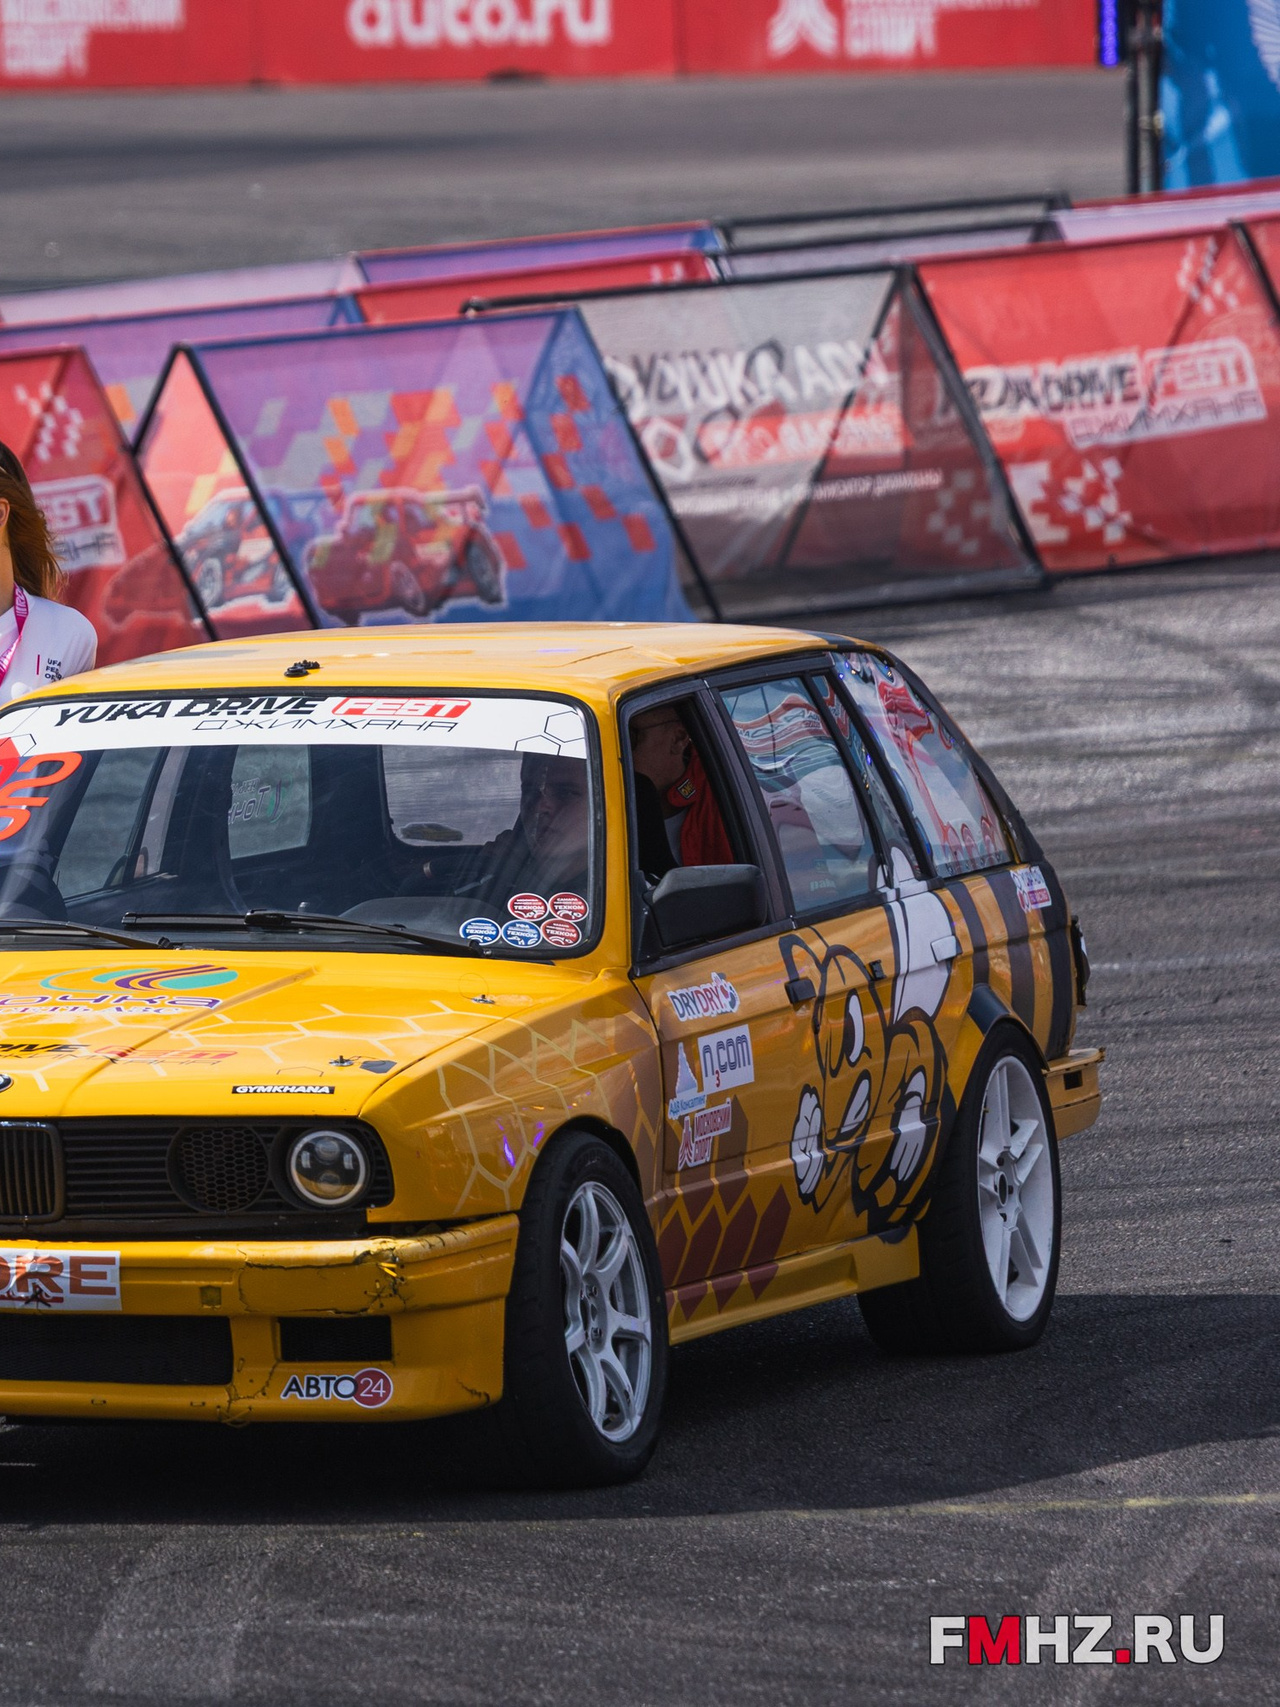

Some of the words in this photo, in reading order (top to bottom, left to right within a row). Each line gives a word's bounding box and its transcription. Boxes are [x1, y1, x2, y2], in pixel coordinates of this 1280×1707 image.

[55, 701, 172, 728] YUKA
[174, 697, 327, 718] DRIVE
[334, 697, 468, 718] FEST
[192, 719, 460, 734] ДЖИМХАНА
[235, 1084, 333, 1095] GYMKHANA
